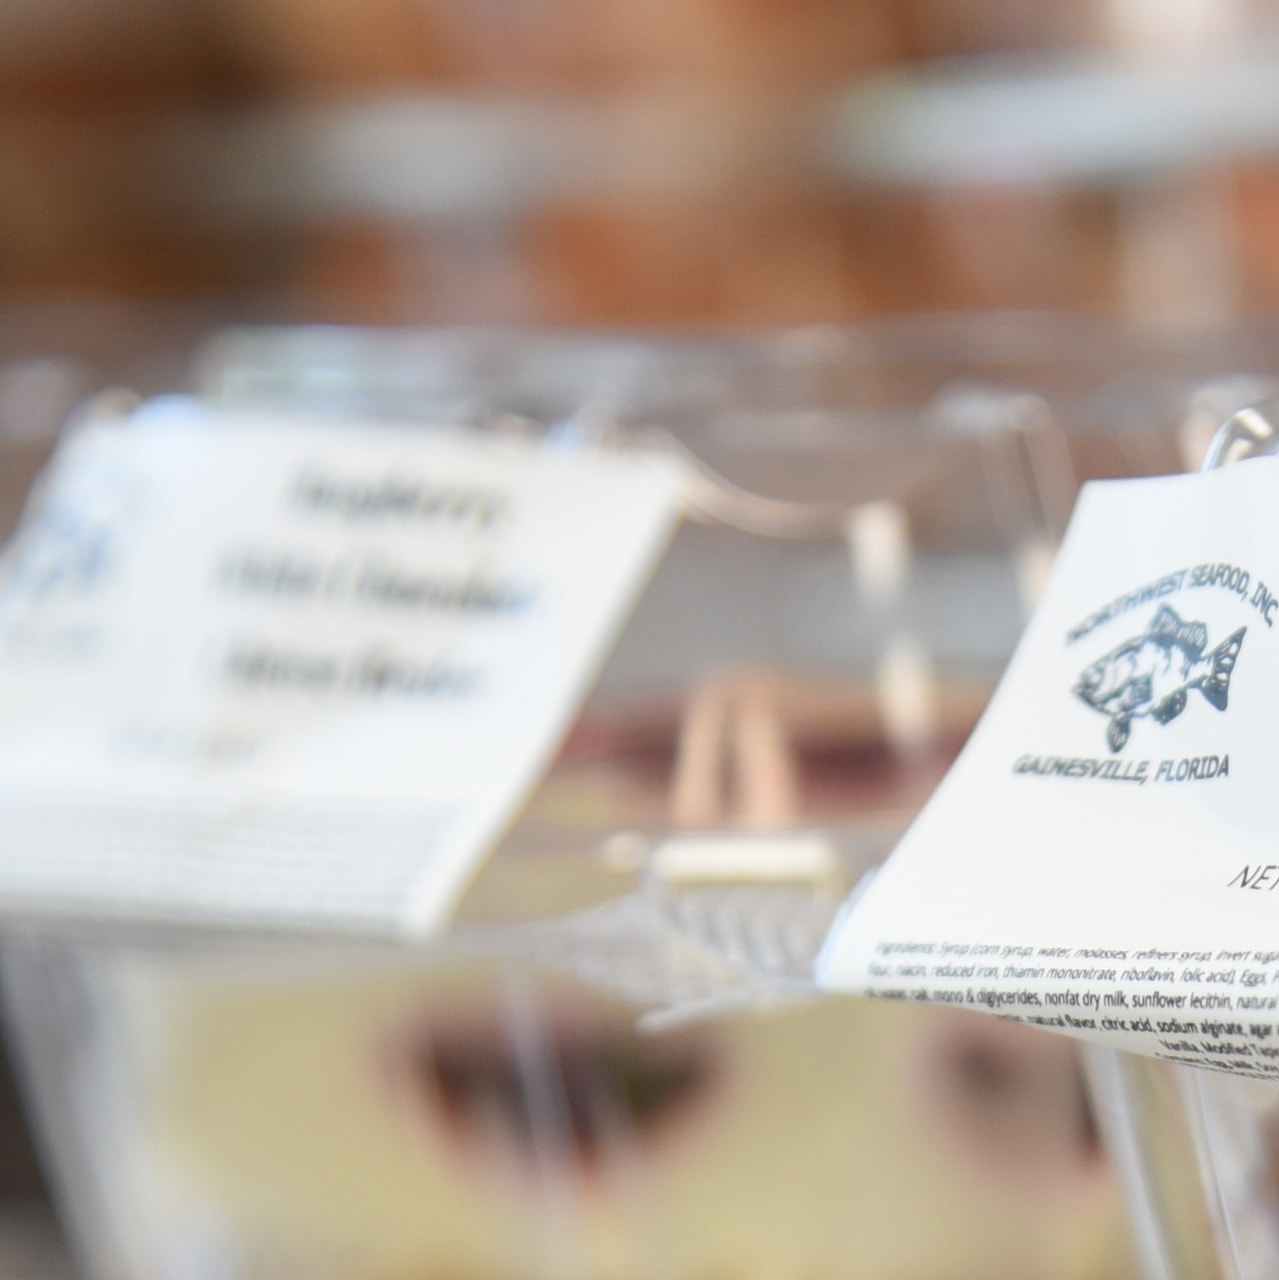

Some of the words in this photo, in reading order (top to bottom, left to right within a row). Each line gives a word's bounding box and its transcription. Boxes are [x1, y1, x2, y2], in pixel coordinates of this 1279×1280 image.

[1189, 563, 1250, 602] SEAFOOD,
[1012, 753, 1149, 785] GAINESVILLE,
[1154, 753, 1230, 783] FLORIDA
[965, 986, 975, 1003] &
[1044, 988, 1081, 1007] nonfat
[1082, 989, 1101, 1012] dry
[1103, 989, 1129, 1010] milk,
[1131, 990, 1188, 1009] sunflower
[1190, 992, 1233, 1011] lecithin,
[1235, 993, 1279, 1010] natural
[1130, 1016, 1157, 1035] acid,
[1156, 1017, 1200, 1035] sodium
[1200, 1018, 1248, 1040] alginate,
